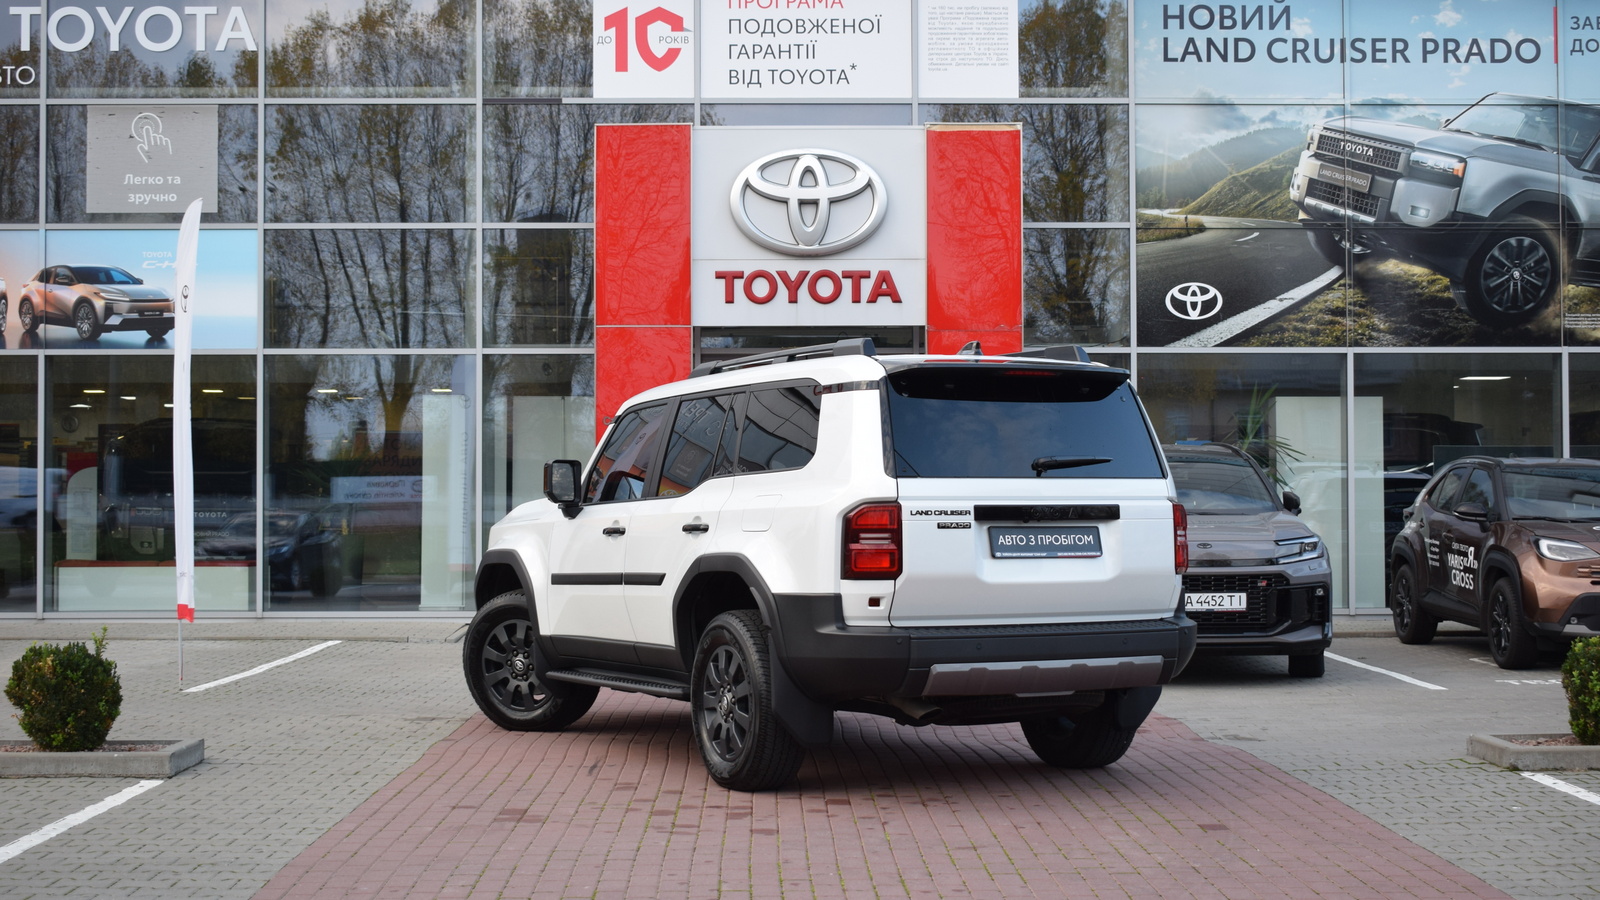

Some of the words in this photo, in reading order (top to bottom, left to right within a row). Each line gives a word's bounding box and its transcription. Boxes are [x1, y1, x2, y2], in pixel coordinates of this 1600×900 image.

[1162, 0, 1291, 30] НОВИЙ
[9, 6, 258, 52] TOYOTA
[728, 14, 883, 37] ПОДОВЖЕНОЇ
[597, 35, 612, 46] ДО
[604, 6, 684, 72] 10
[659, 35, 690, 45] РОКІВ
[728, 40, 817, 60] ГАРАНТІЇ
[1162, 38, 1257, 64] LAND
[1266, 38, 1412, 64] CRUISER
[1421, 38, 1542, 64] PRADO
[0, 65, 36, 85] ТО
[728, 69, 762, 88] ВІД
[1340, 142, 1373, 157] TOYOTA
[123, 174, 164, 186] Легко
[166, 175, 181, 185] та
[127, 192, 177, 205] зручно
[714, 269, 903, 305] TOYOTA
[998, 534, 1027, 546] АВТО
[1028, 534, 1036, 546] З
[1037, 534, 1095, 546] ПРОБІГОМ
[1447, 552, 1464, 570] YARIS
[1451, 569, 1474, 590] CROSS
[1196, 595, 1225, 607] 4452
[1227, 595, 1242, 607] TI
